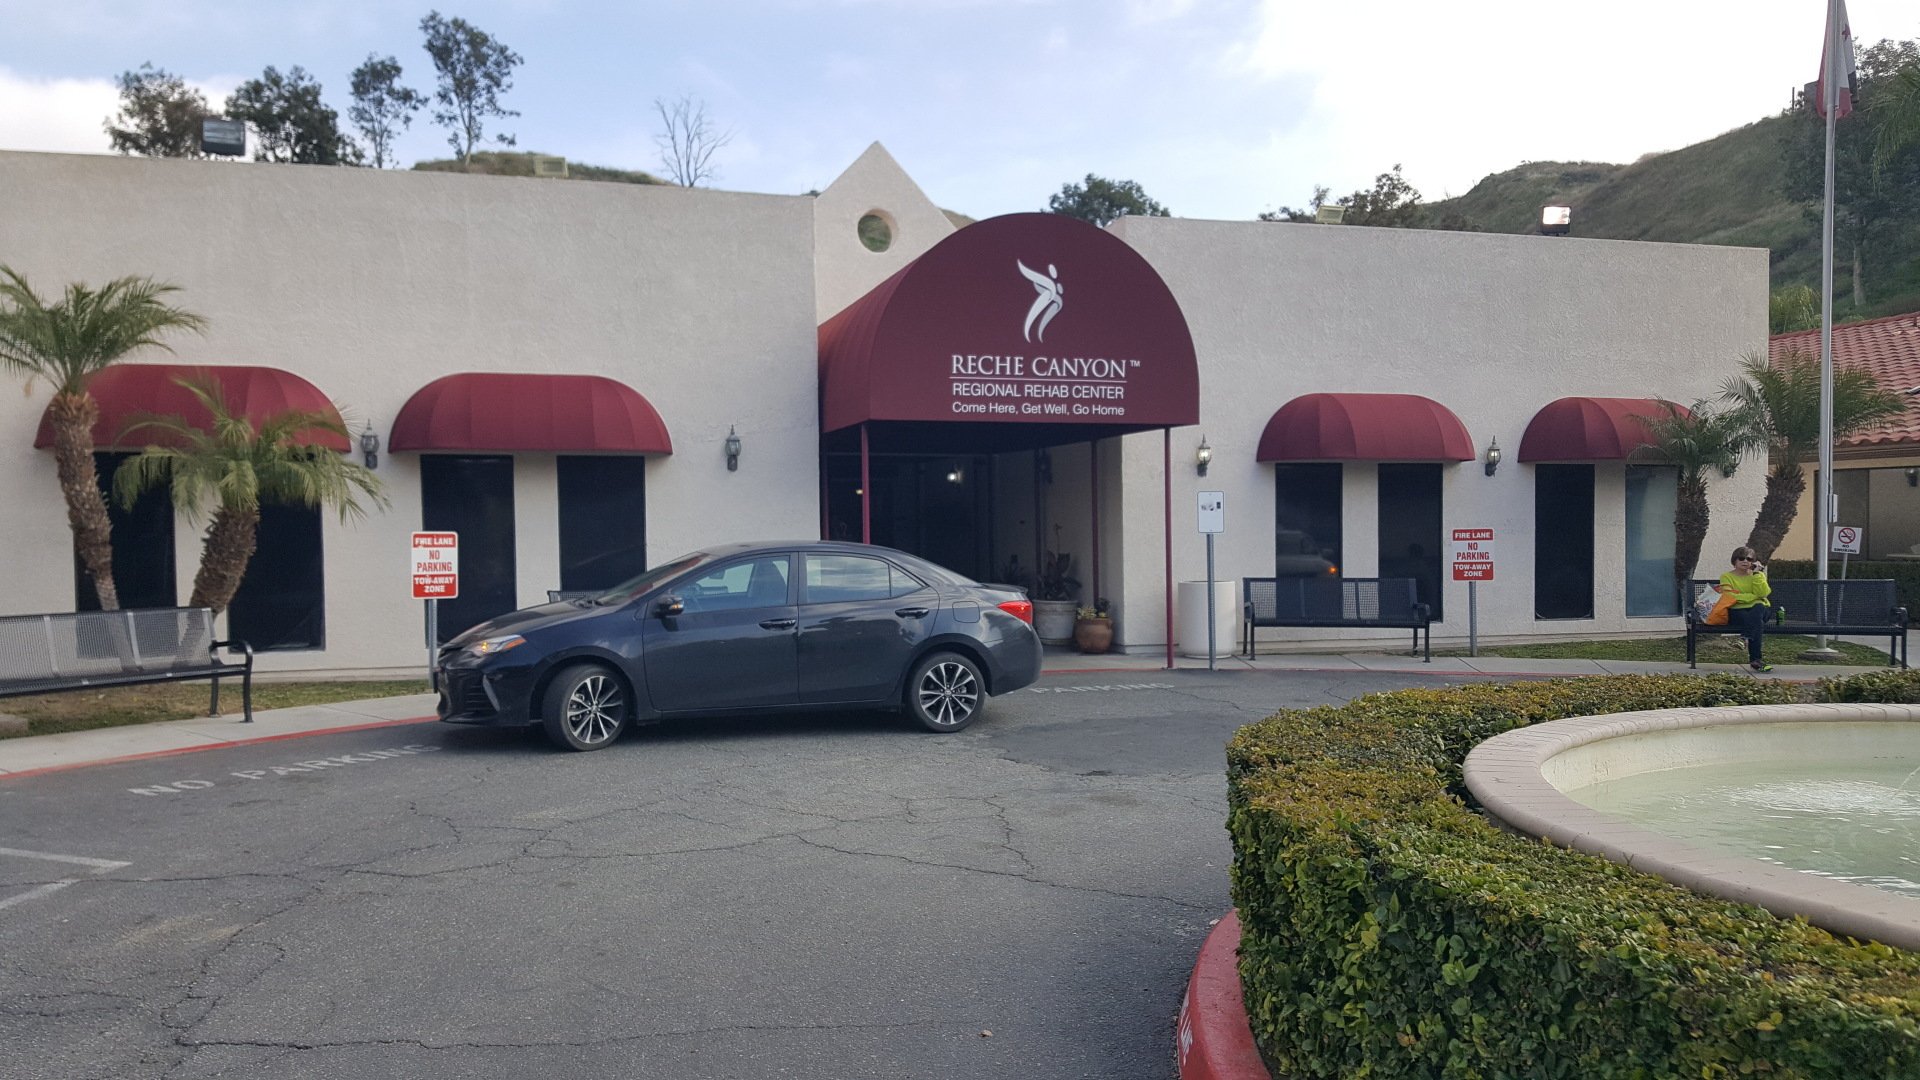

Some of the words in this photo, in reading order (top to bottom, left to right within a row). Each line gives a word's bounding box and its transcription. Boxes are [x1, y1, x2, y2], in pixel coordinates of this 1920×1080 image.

[951, 354, 1024, 376] RECHE
[1031, 357, 1127, 378] CANYON
[952, 383, 1021, 398] REGIONAL
[1024, 384, 1069, 398] REHAB
[1072, 386, 1124, 399] CENTER
[952, 402, 986, 413] Come
[989, 403, 1018, 415] Here,
[1021, 403, 1042, 414] Get
[1044, 404, 1070, 415] Well,
[1073, 404, 1089, 415] Go
[1092, 405, 1125, 416] Home
[414, 537, 432, 545] FIRE
[433, 537, 454, 545] LANE
[1467, 542, 1478, 550] NO
[429, 550, 440, 560] NO
[1456, 552, 1490, 560] PARKING
[416, 562, 452, 572] PARKING
[414, 577, 454, 585] TOW-AWAY
[424, 585, 446, 593] ZONE
[126, 779, 215, 796] NO
[230, 744, 443, 780] PARKING
